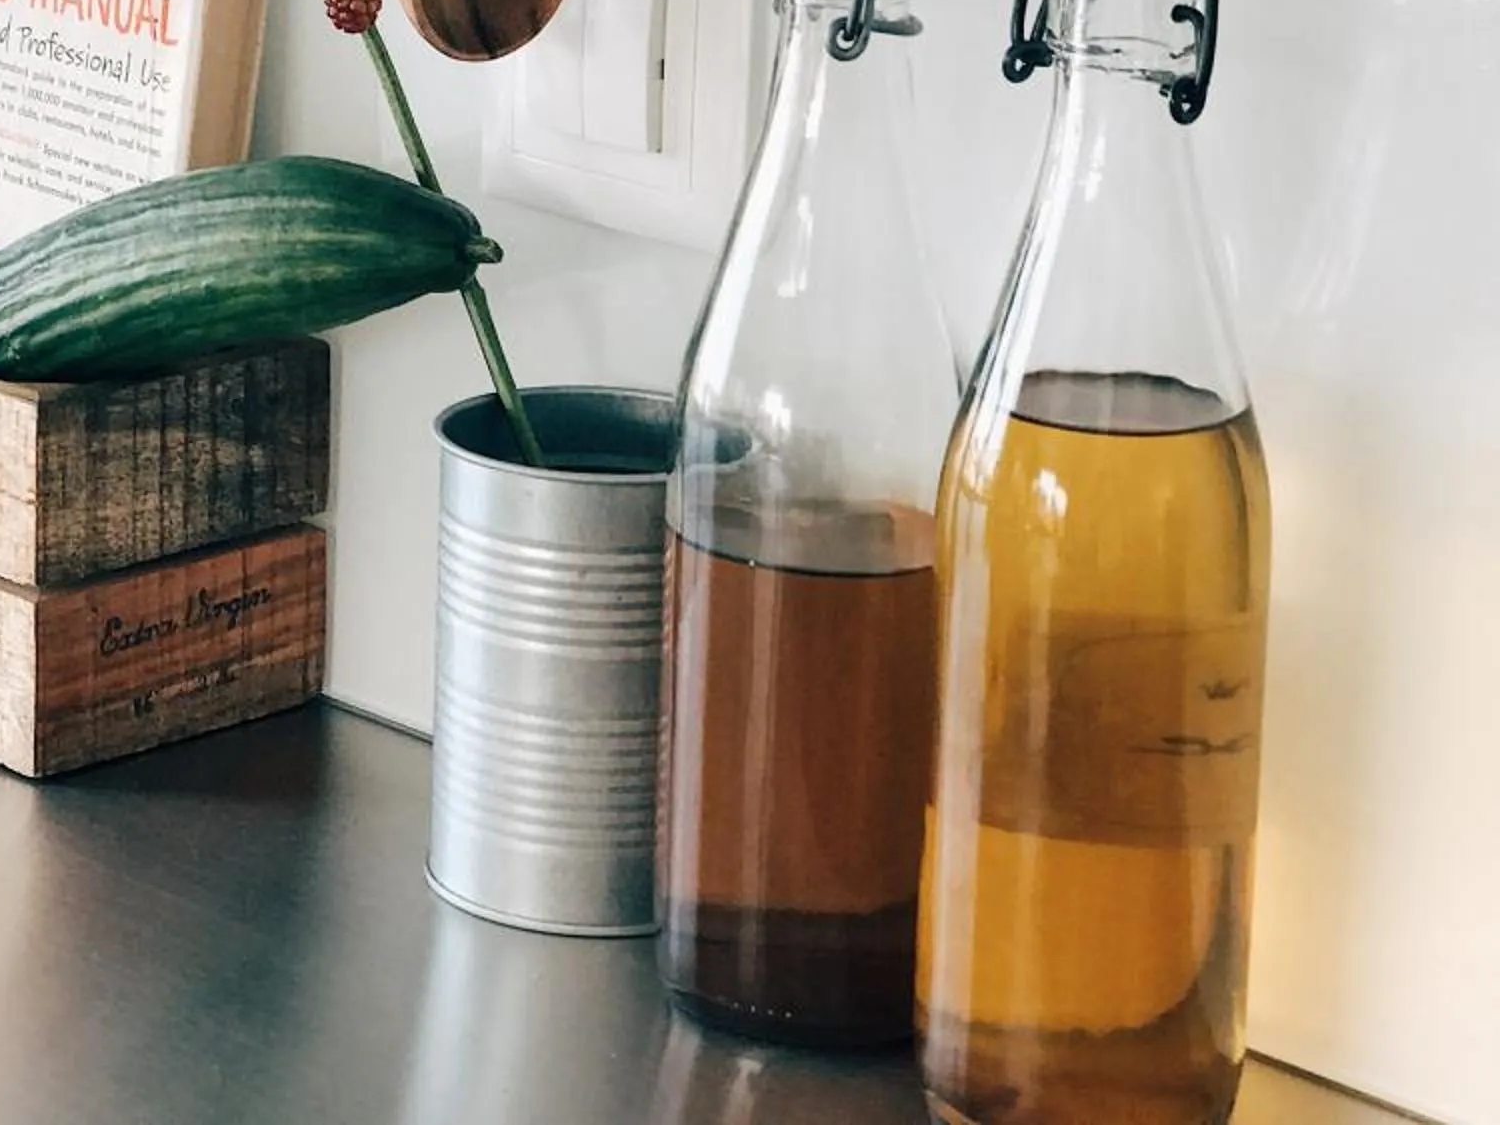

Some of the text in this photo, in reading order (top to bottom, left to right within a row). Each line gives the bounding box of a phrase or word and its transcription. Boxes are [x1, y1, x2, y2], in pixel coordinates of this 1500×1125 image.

[18, 26, 132, 84] Professional
[140, 55, 173, 93] Use
[100, 586, 272, 657] Extra Virgin
